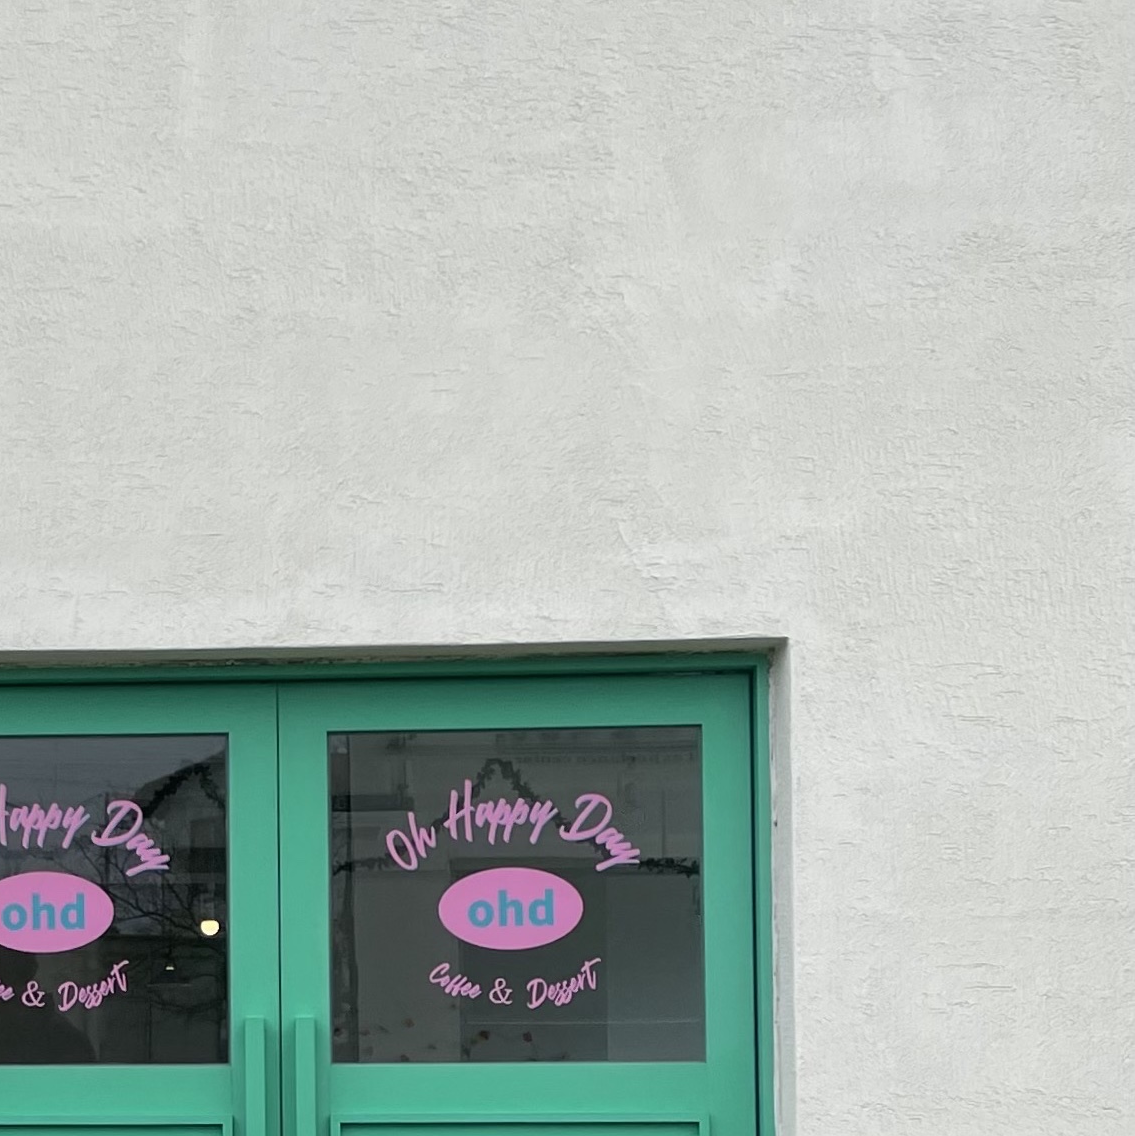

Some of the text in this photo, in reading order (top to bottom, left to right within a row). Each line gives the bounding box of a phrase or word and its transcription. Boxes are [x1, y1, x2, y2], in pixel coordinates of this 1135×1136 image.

[91, 799, 170, 877] Day
[386, 779, 641, 872] Oh Happy Day
[1, 893, 86, 931] ohd
[468, 889, 555, 928] ohd
[21, 981, 46, 1007] &
[429, 963, 482, 998] Coffee
[489, 978, 513, 1005] &
